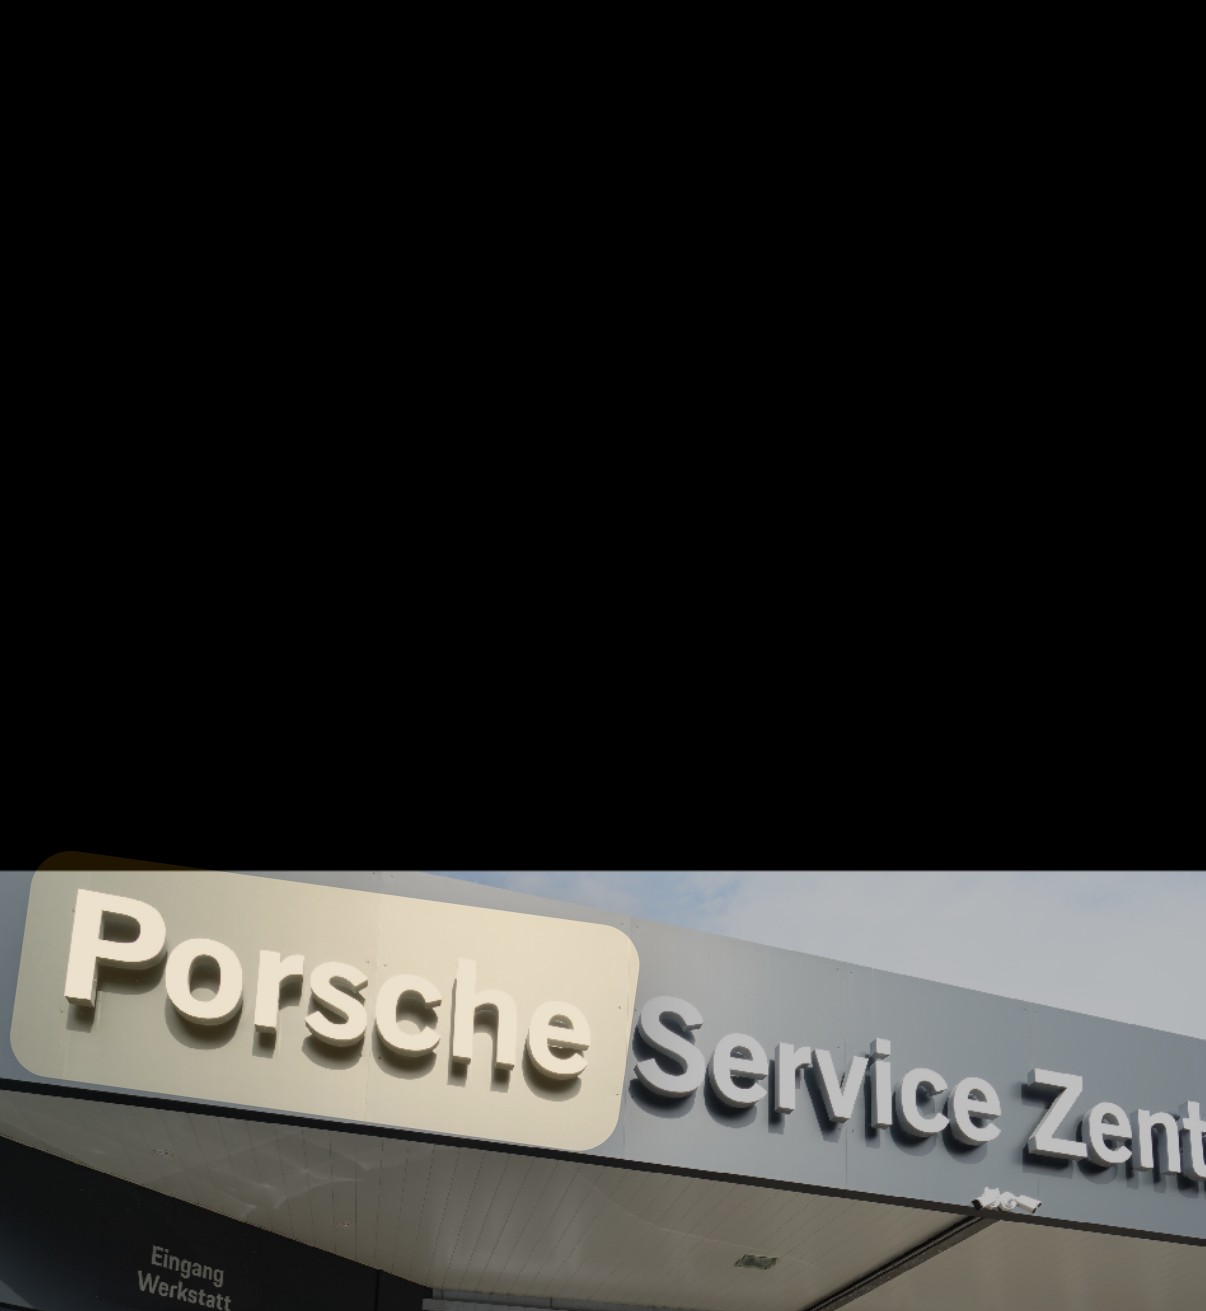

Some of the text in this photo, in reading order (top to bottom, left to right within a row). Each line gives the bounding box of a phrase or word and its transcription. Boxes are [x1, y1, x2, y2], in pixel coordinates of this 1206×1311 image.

[64, 889, 1206, 1181] Porsche Service Zent
[151, 1245, 224, 1288] Eingang
[137, 1270, 232, 1311] Werkstatt
